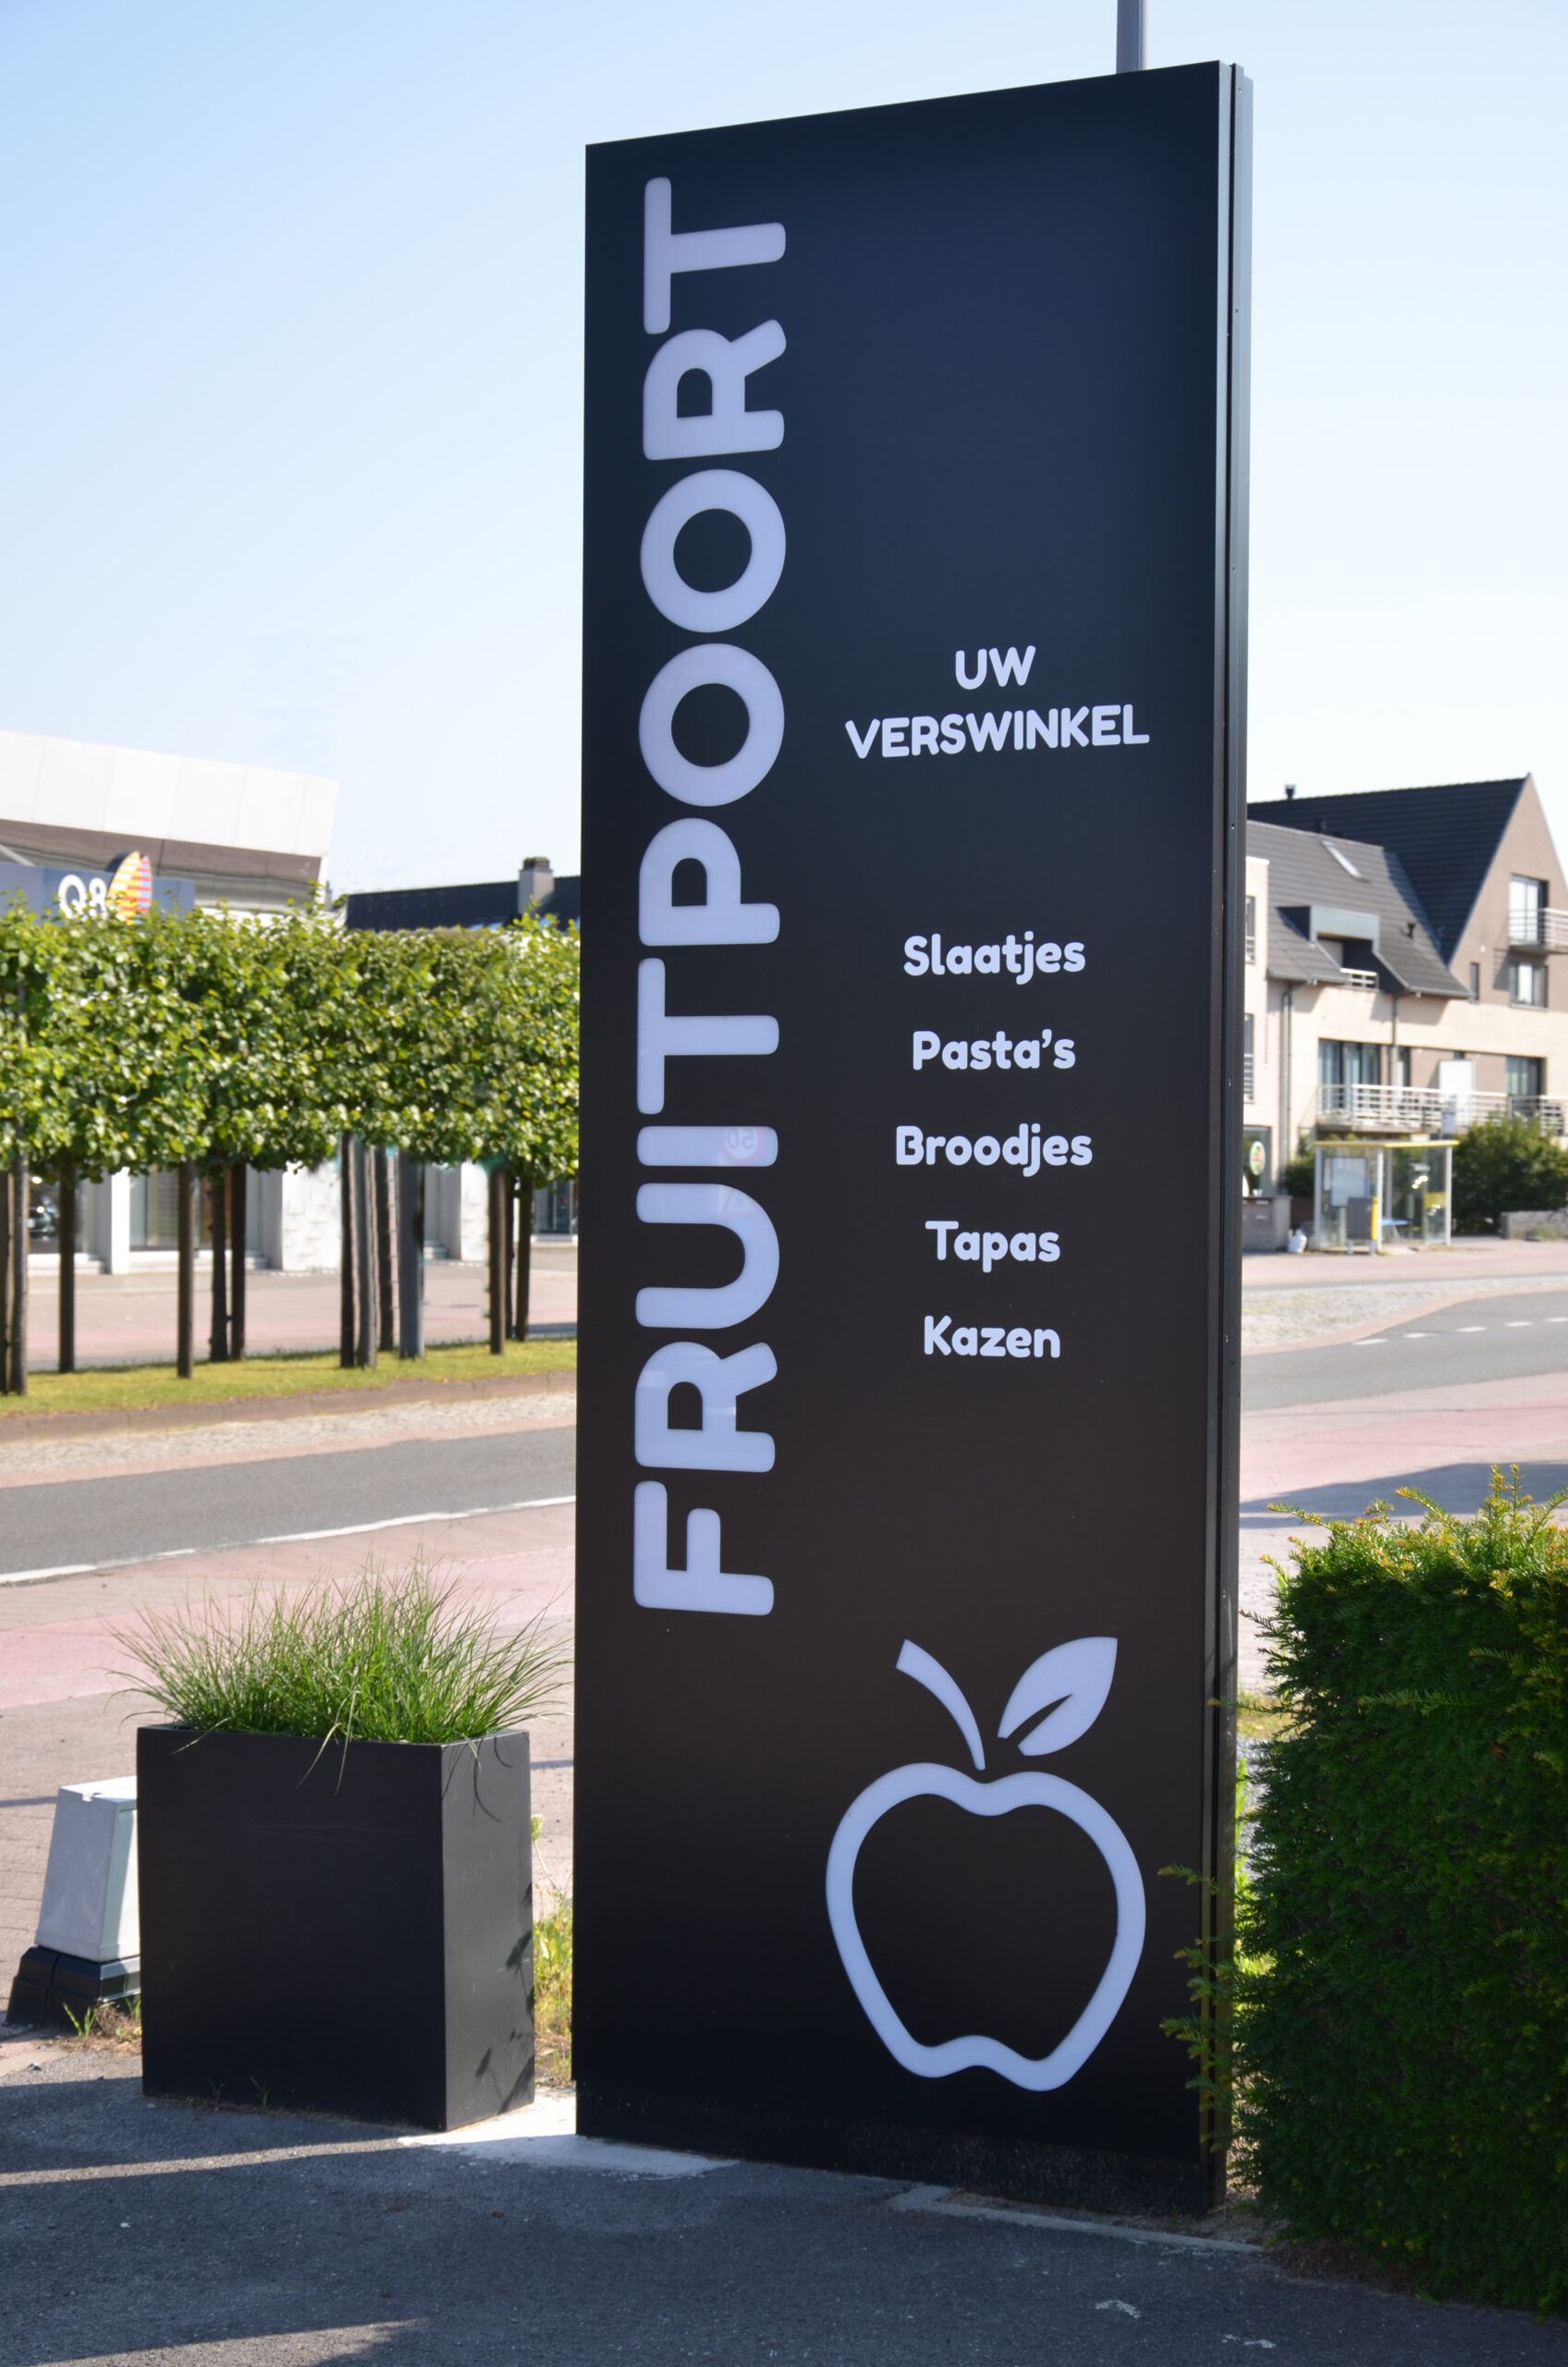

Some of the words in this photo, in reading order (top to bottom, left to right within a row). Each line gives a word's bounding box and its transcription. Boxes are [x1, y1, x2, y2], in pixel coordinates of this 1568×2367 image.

[955, 644, 1036, 691] UW
[845, 704, 1150, 759] VERSWINKEL
[58, 875, 108, 922] Q8
[634, 179, 787, 1616] FRUITPOORT
[903, 930, 1086, 986] Slaatjes
[896, 1122, 1093, 1178] Broodjes
[925, 1220, 1061, 1273] Tapas
[924, 1315, 1061, 1358] Kazen
